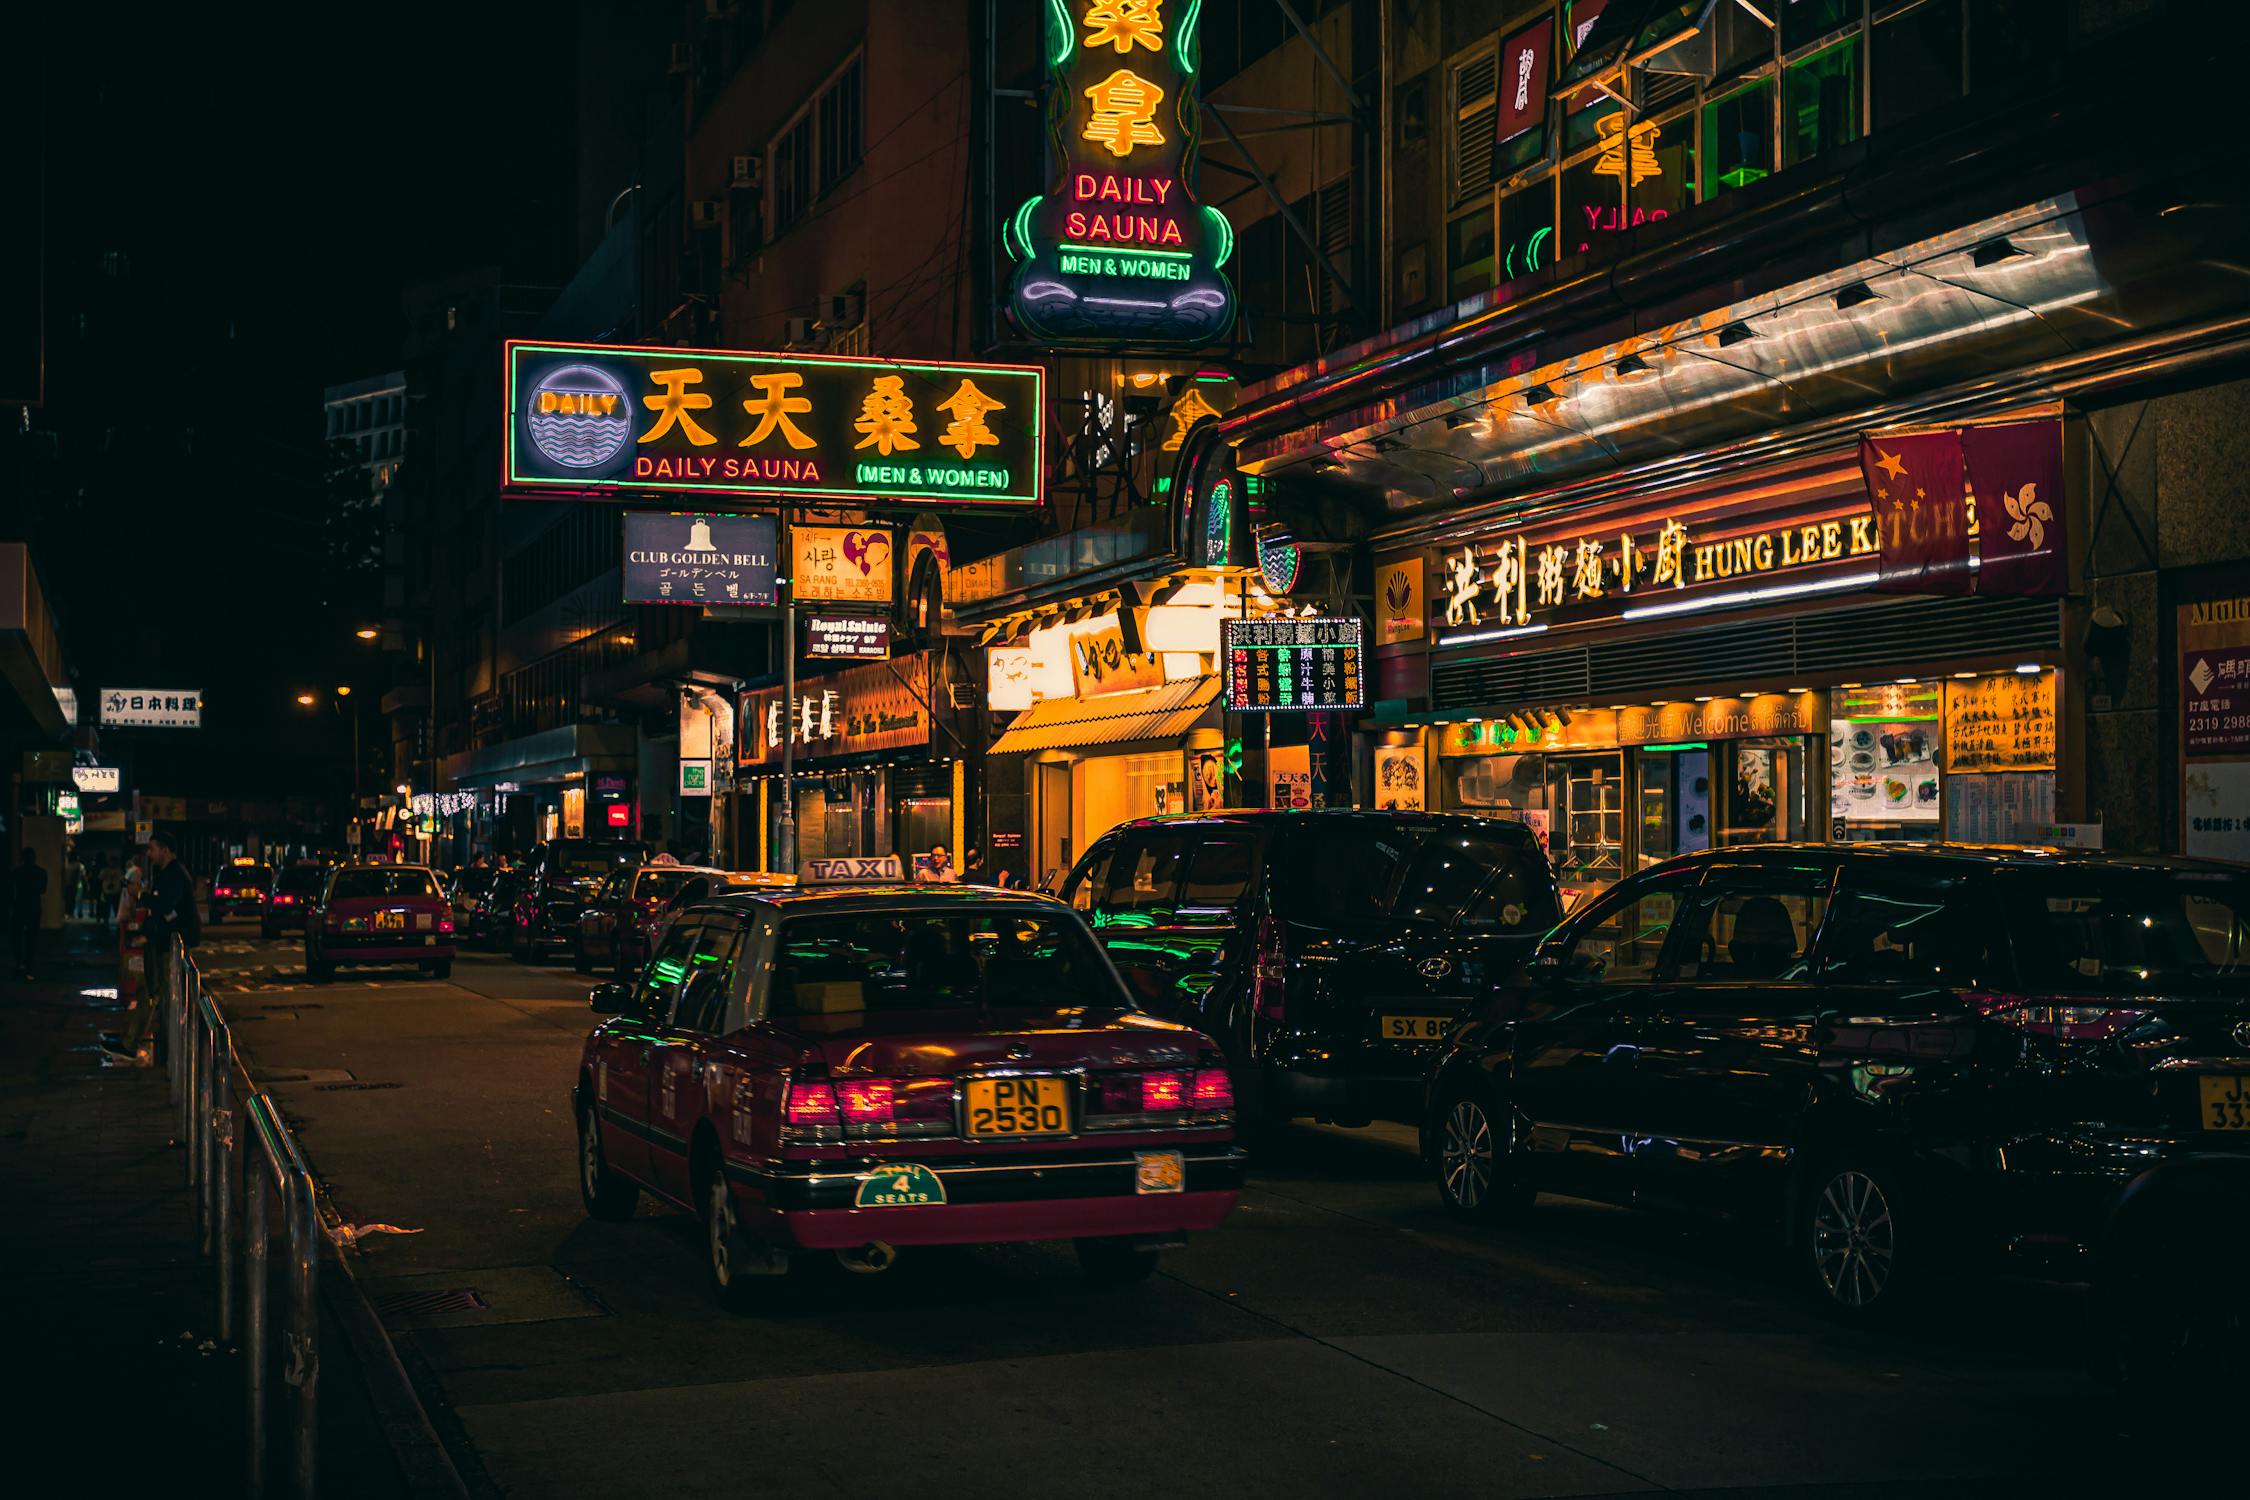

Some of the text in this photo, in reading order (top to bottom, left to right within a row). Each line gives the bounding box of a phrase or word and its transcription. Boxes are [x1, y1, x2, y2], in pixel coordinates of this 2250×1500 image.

[1074, 173, 1172, 205] DAILY
[1065, 211, 1183, 245] SAUNA
[1060, 255, 1192, 281] MEN & WOMEN
[540, 391, 618, 415] DAILY
[636, 367, 1007, 460] 天天桑拿
[636, 456, 821, 481] DAILY SAUNA
[855, 463, 1010, 489] (MEN & WOMEN)
[629, 551, 770, 567] CLUB GOLDEN BELL
[803, 546, 838, 572] 사랑
[1694, 536, 1774, 582] HUNG
[1780, 520, 1843, 567] LEE
[811, 619, 887, 634] Royal Salute
[131, 695, 197, 712] 日本料理
[1680, 708, 1749, 736] Welcome
[2189, 716, 2219, 732] 2319
[808, 858, 898, 882] TAXI
[1393, 1018, 1418, 1037] SX
[994, 1081, 1040, 1106] PN
[2224, 1076, 2250, 1102] J
[973, 1105, 1063, 1135] 2530
[891, 1174, 911, 1193] 4
[874, 1192, 929, 1204] SEATS
